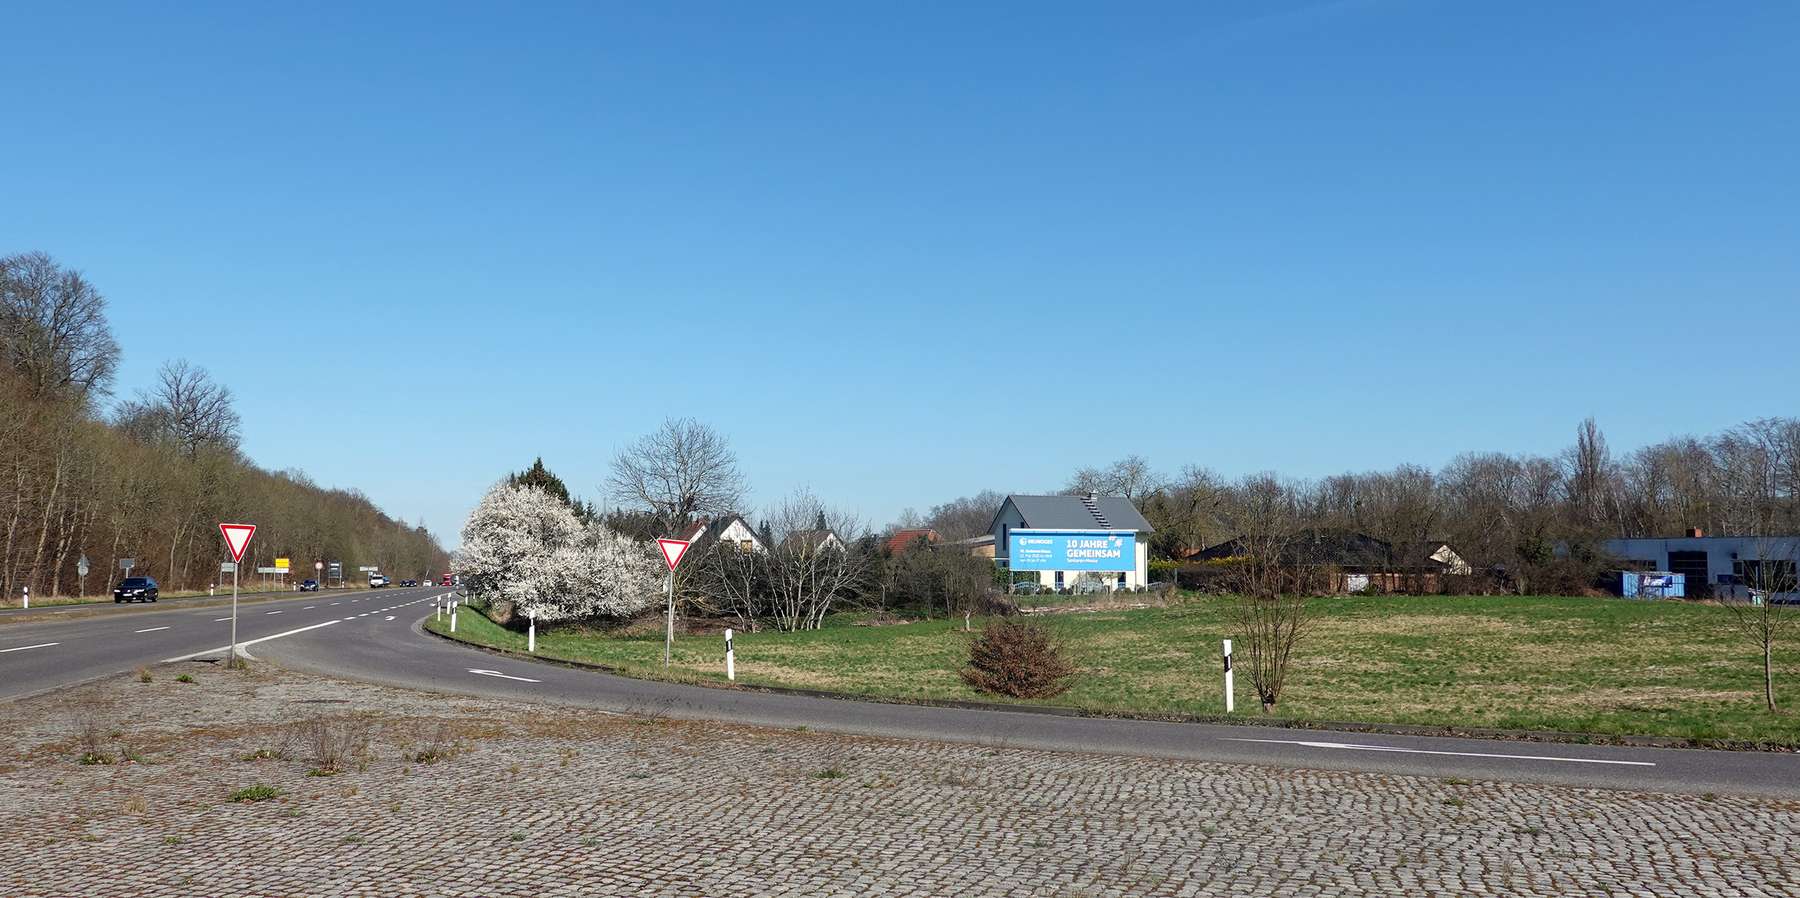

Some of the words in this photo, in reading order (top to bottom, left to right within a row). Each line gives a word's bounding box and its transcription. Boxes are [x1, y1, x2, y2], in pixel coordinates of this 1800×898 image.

[1067, 540, 1077, 549] 10
[1080, 540, 1108, 549] JAHRE
[1067, 549, 1121, 558] GEMEINSAM
